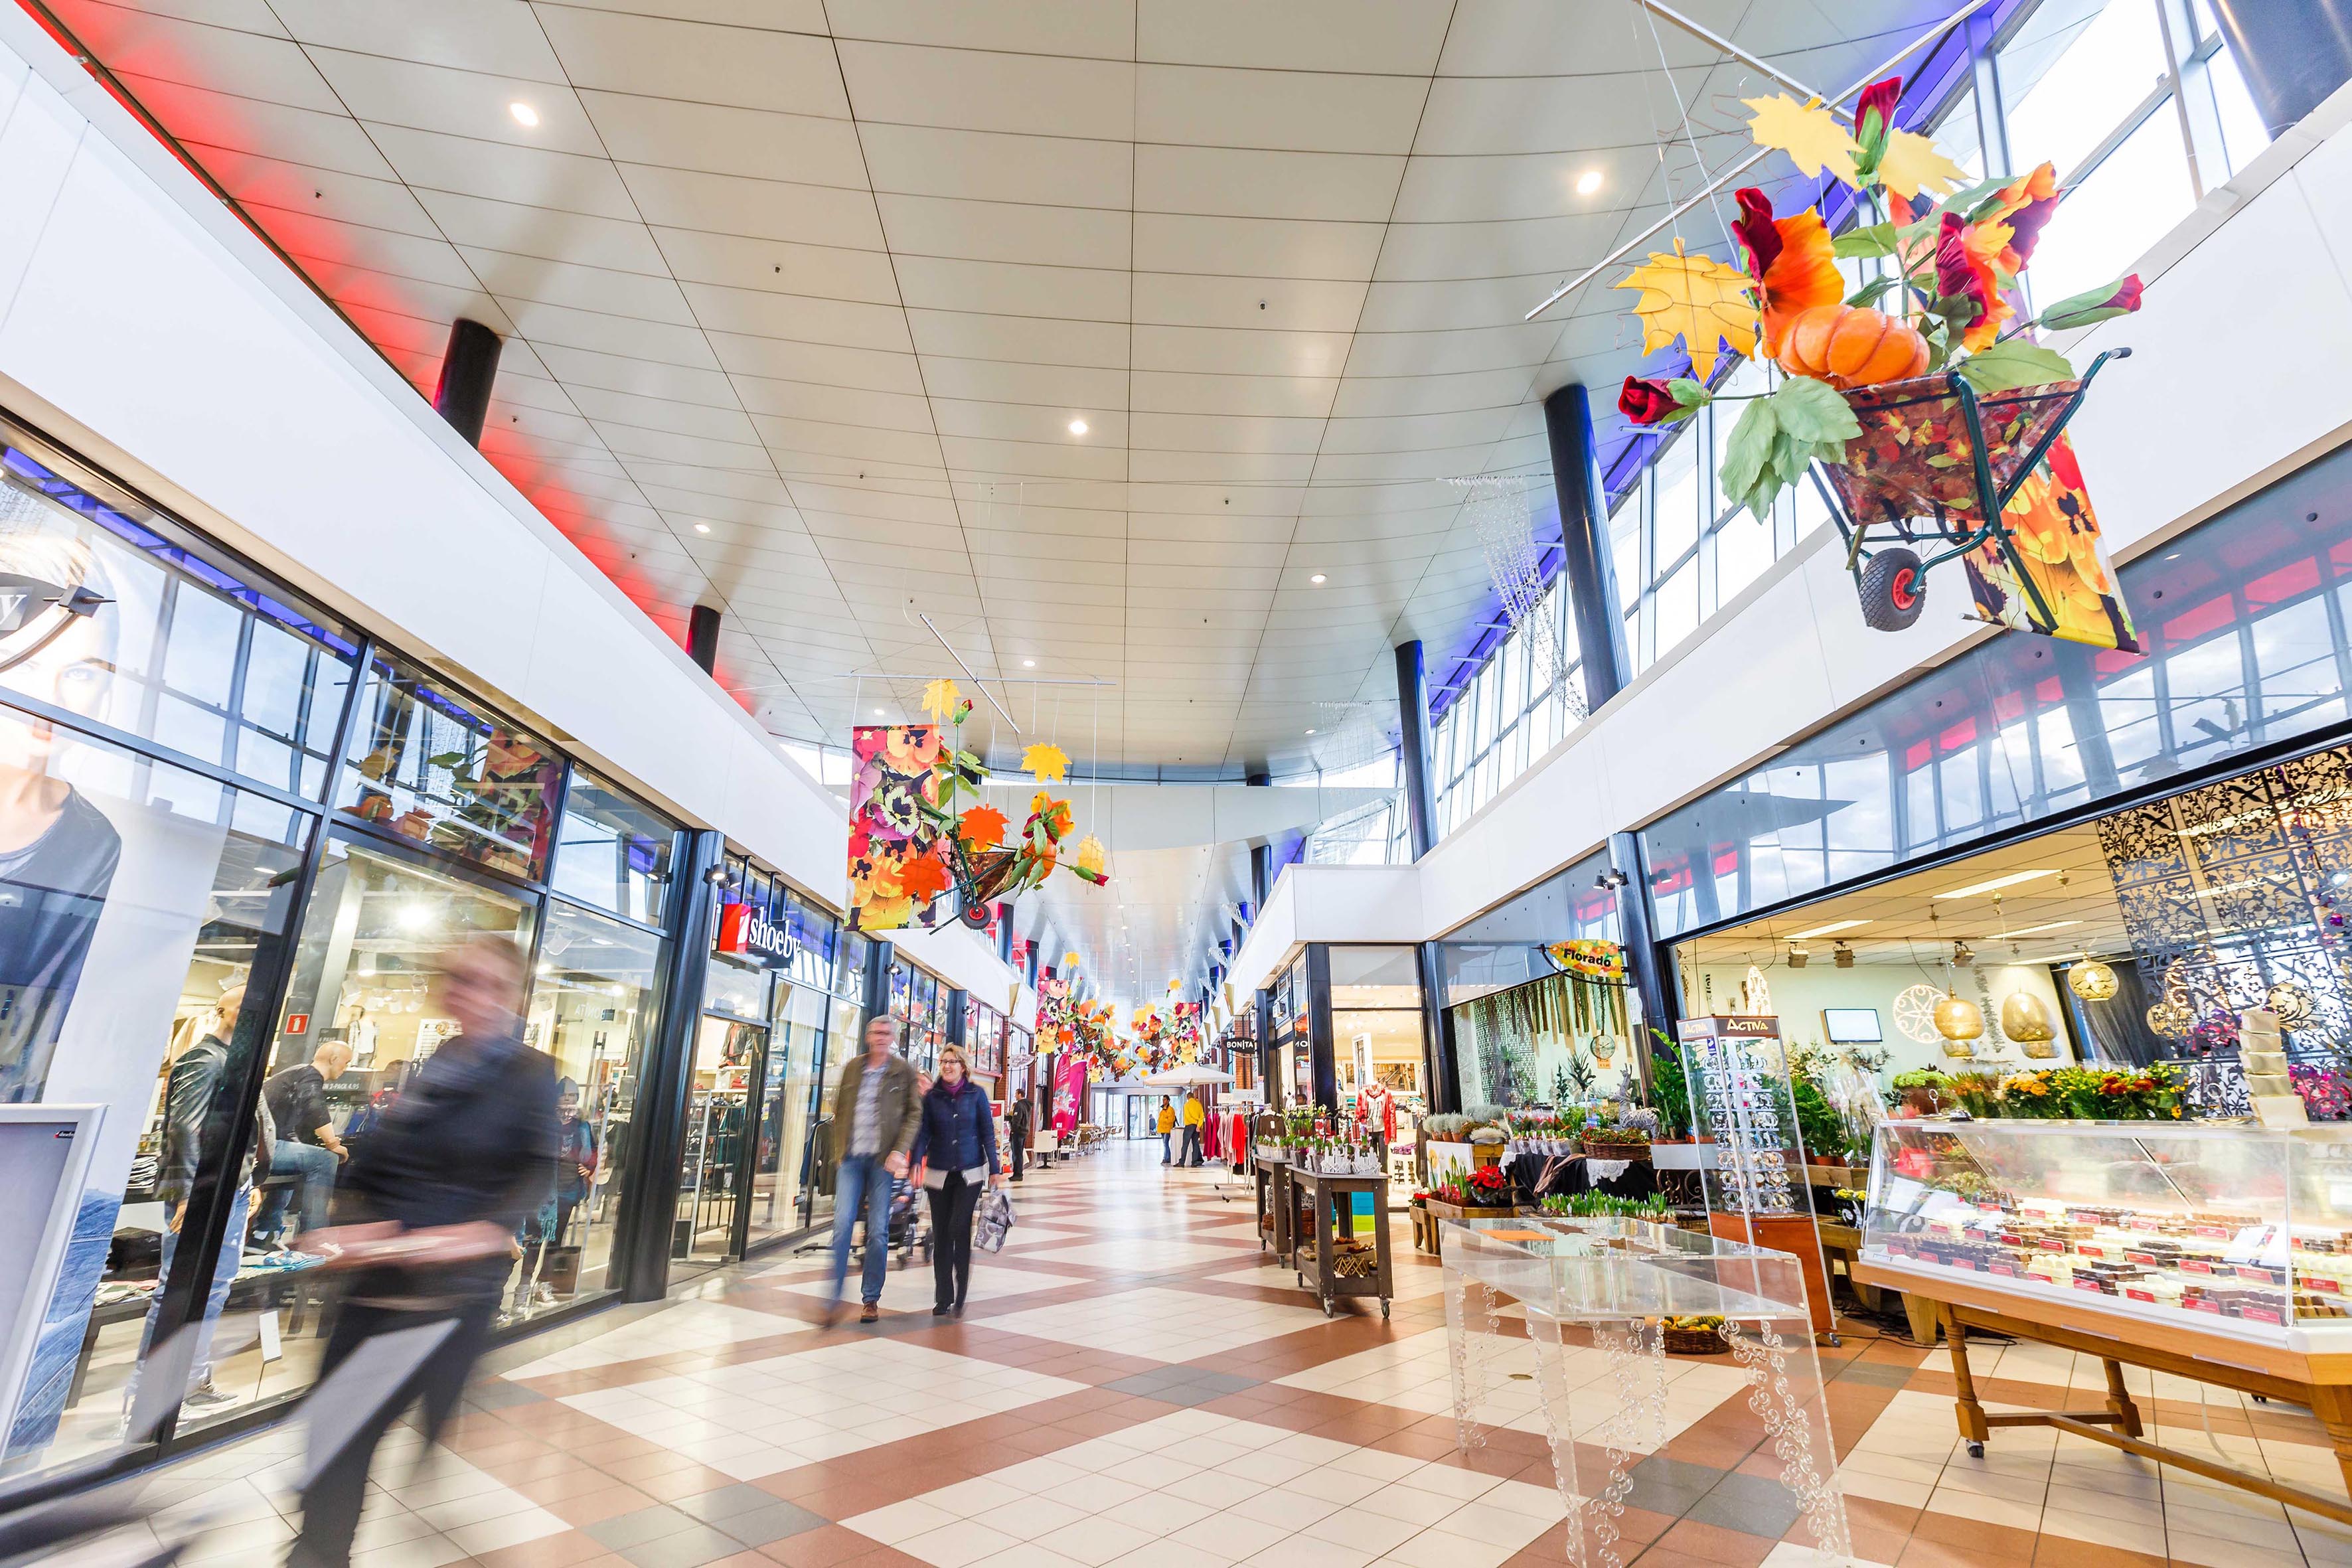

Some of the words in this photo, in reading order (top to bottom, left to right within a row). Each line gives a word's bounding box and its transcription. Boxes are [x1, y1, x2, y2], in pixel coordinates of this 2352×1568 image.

[749, 906, 801, 969] shoeby
[1563, 948, 1611, 967] Florado
[1226, 1040, 1254, 1050] BONITA
